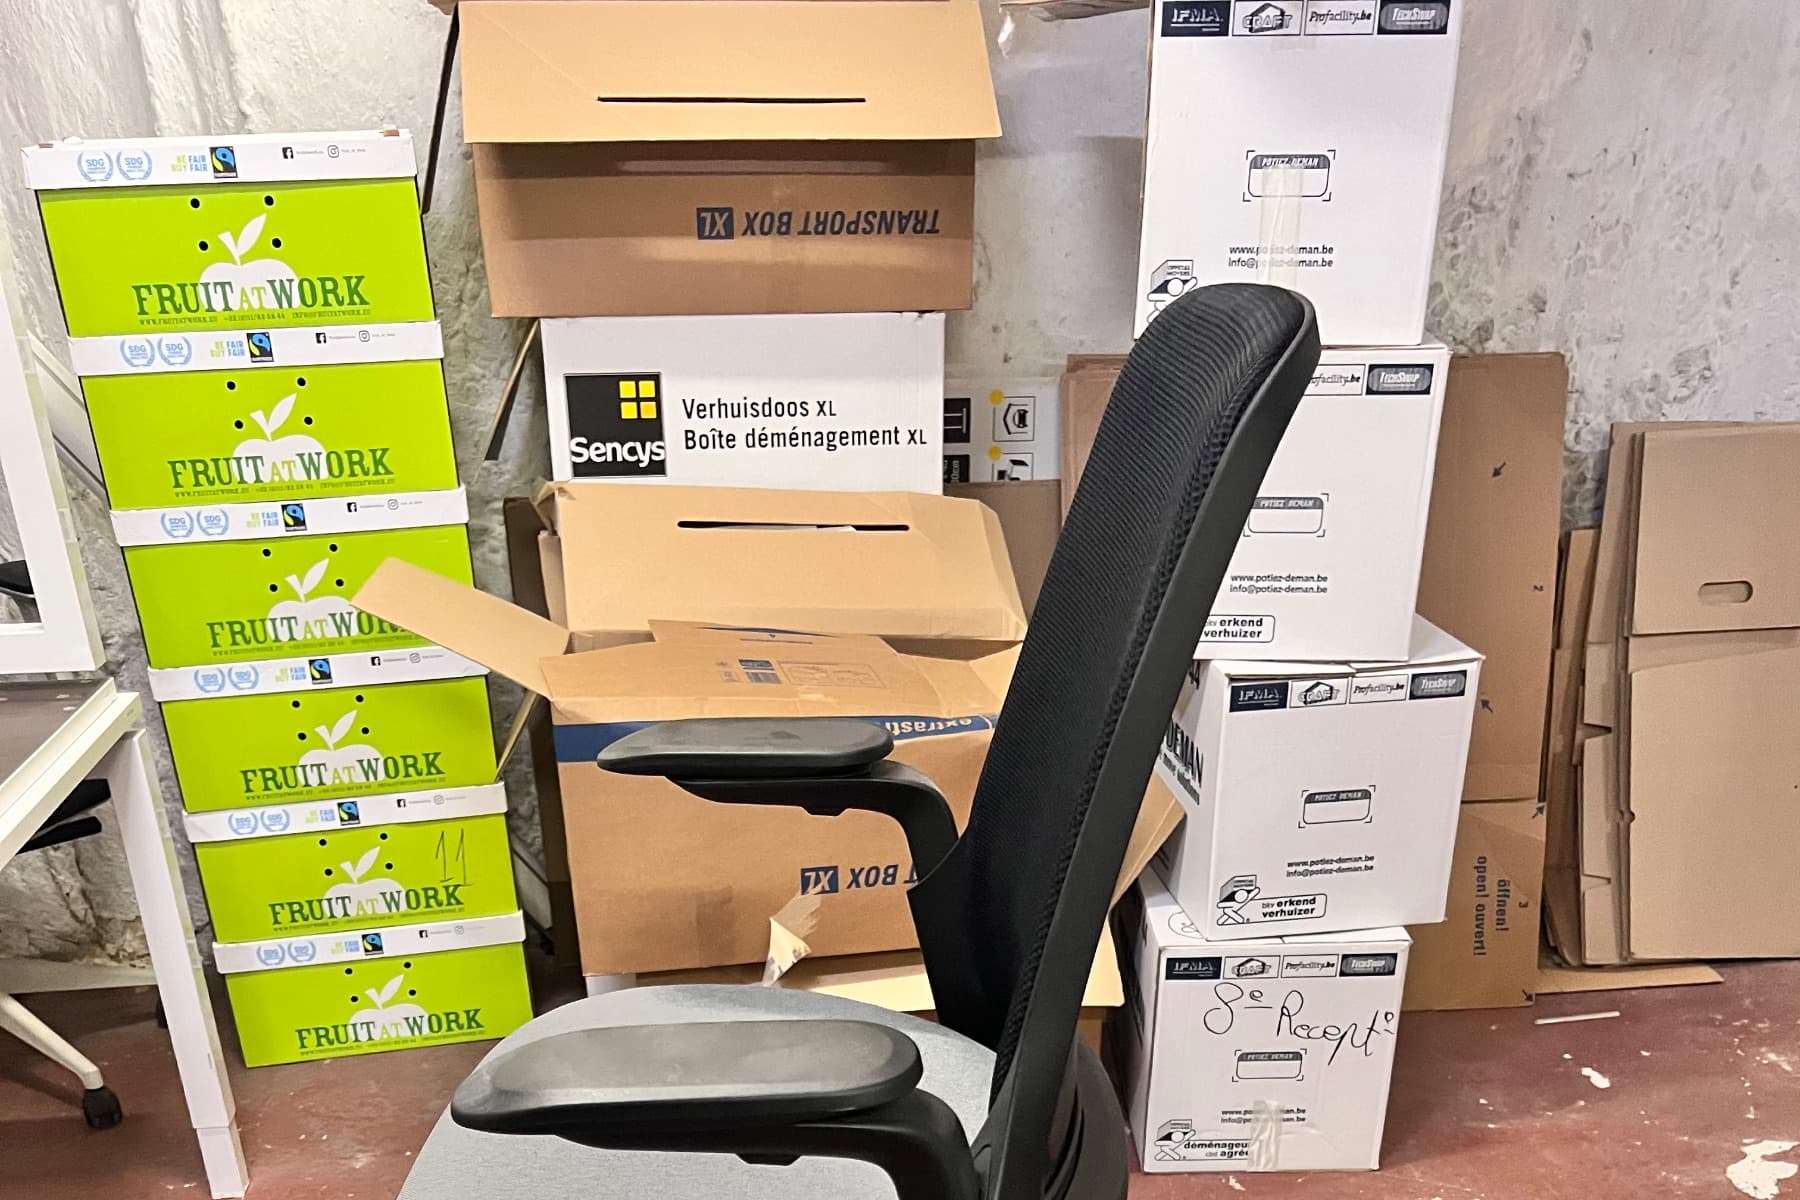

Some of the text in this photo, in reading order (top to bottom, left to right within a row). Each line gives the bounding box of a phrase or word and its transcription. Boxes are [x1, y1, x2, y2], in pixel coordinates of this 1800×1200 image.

[86, 159, 105, 167] SDG
[124, 157, 143, 166] SDG
[188, 155, 207, 163] FAIR
[189, 163, 208, 172] FAIR
[700, 209, 941, 237] TRANSPORT BOX XL
[131, 275, 370, 316] FRUIT AT WORK
[128, 344, 147, 353] SDG
[165, 343, 184, 352] SDG
[226, 340, 244, 349] FAIR
[682, 397, 837, 420] Verhuisdoos XL
[684, 425, 928, 451] Boîte déménagement XL
[569, 437, 666, 468] Sencys
[168, 448, 394, 488] FRUIT AT WORK
[206, 609, 406, 648] FRUIT AT WOR
[1203, 628, 1262, 638] verhuizer
[1219, 618, 1264, 627] erkend
[240, 763, 328, 793] FRUIT
[331, 766, 356, 785] AT
[356, 752, 445, 782] WORK
[803, 869, 834, 892] XL
[846, 863, 898, 889] BOX
[1473, 856, 1489, 898] open!
[269, 884, 465, 925] FRUIT AT WORK
[1262, 907, 1316, 918] verhuizer
[1276, 897, 1317, 907] erkend
[296, 1022, 376, 1049] FRUIT
[380, 1023, 404, 1041] AT
[404, 1008, 485, 1037] WORK
[1184, 1141, 1248, 1151] déménageu
